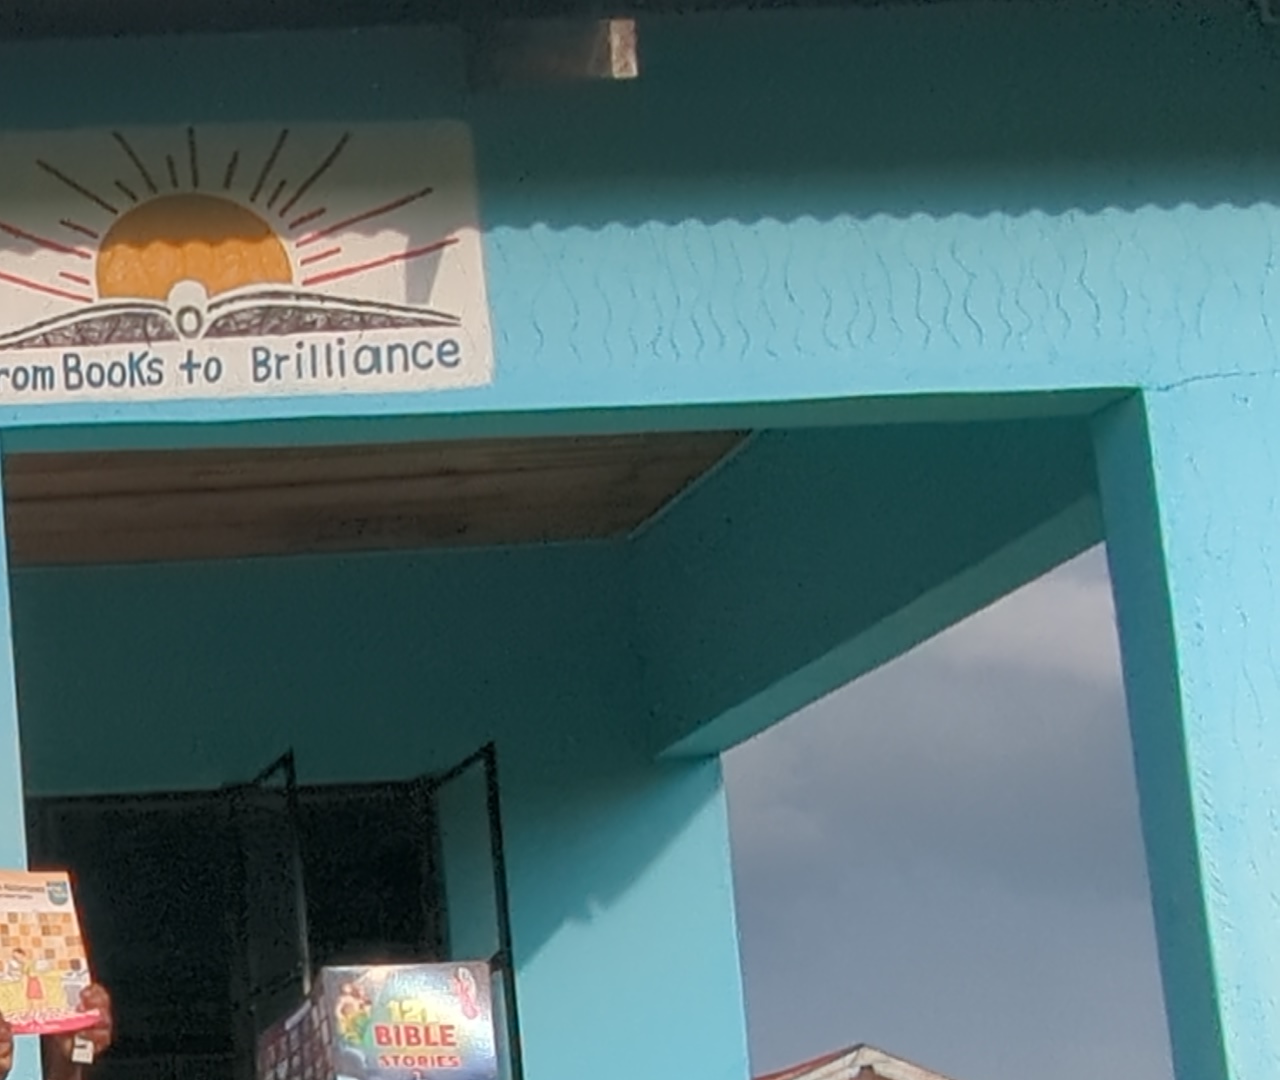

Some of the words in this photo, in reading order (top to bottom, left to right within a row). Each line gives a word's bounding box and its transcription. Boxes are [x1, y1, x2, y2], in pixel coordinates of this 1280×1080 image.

[179, 349, 223, 384] to
[252, 337, 462, 383] Brilliance
[373, 1022, 458, 1048] BIBLE
[378, 1054, 462, 1070] STORIES
